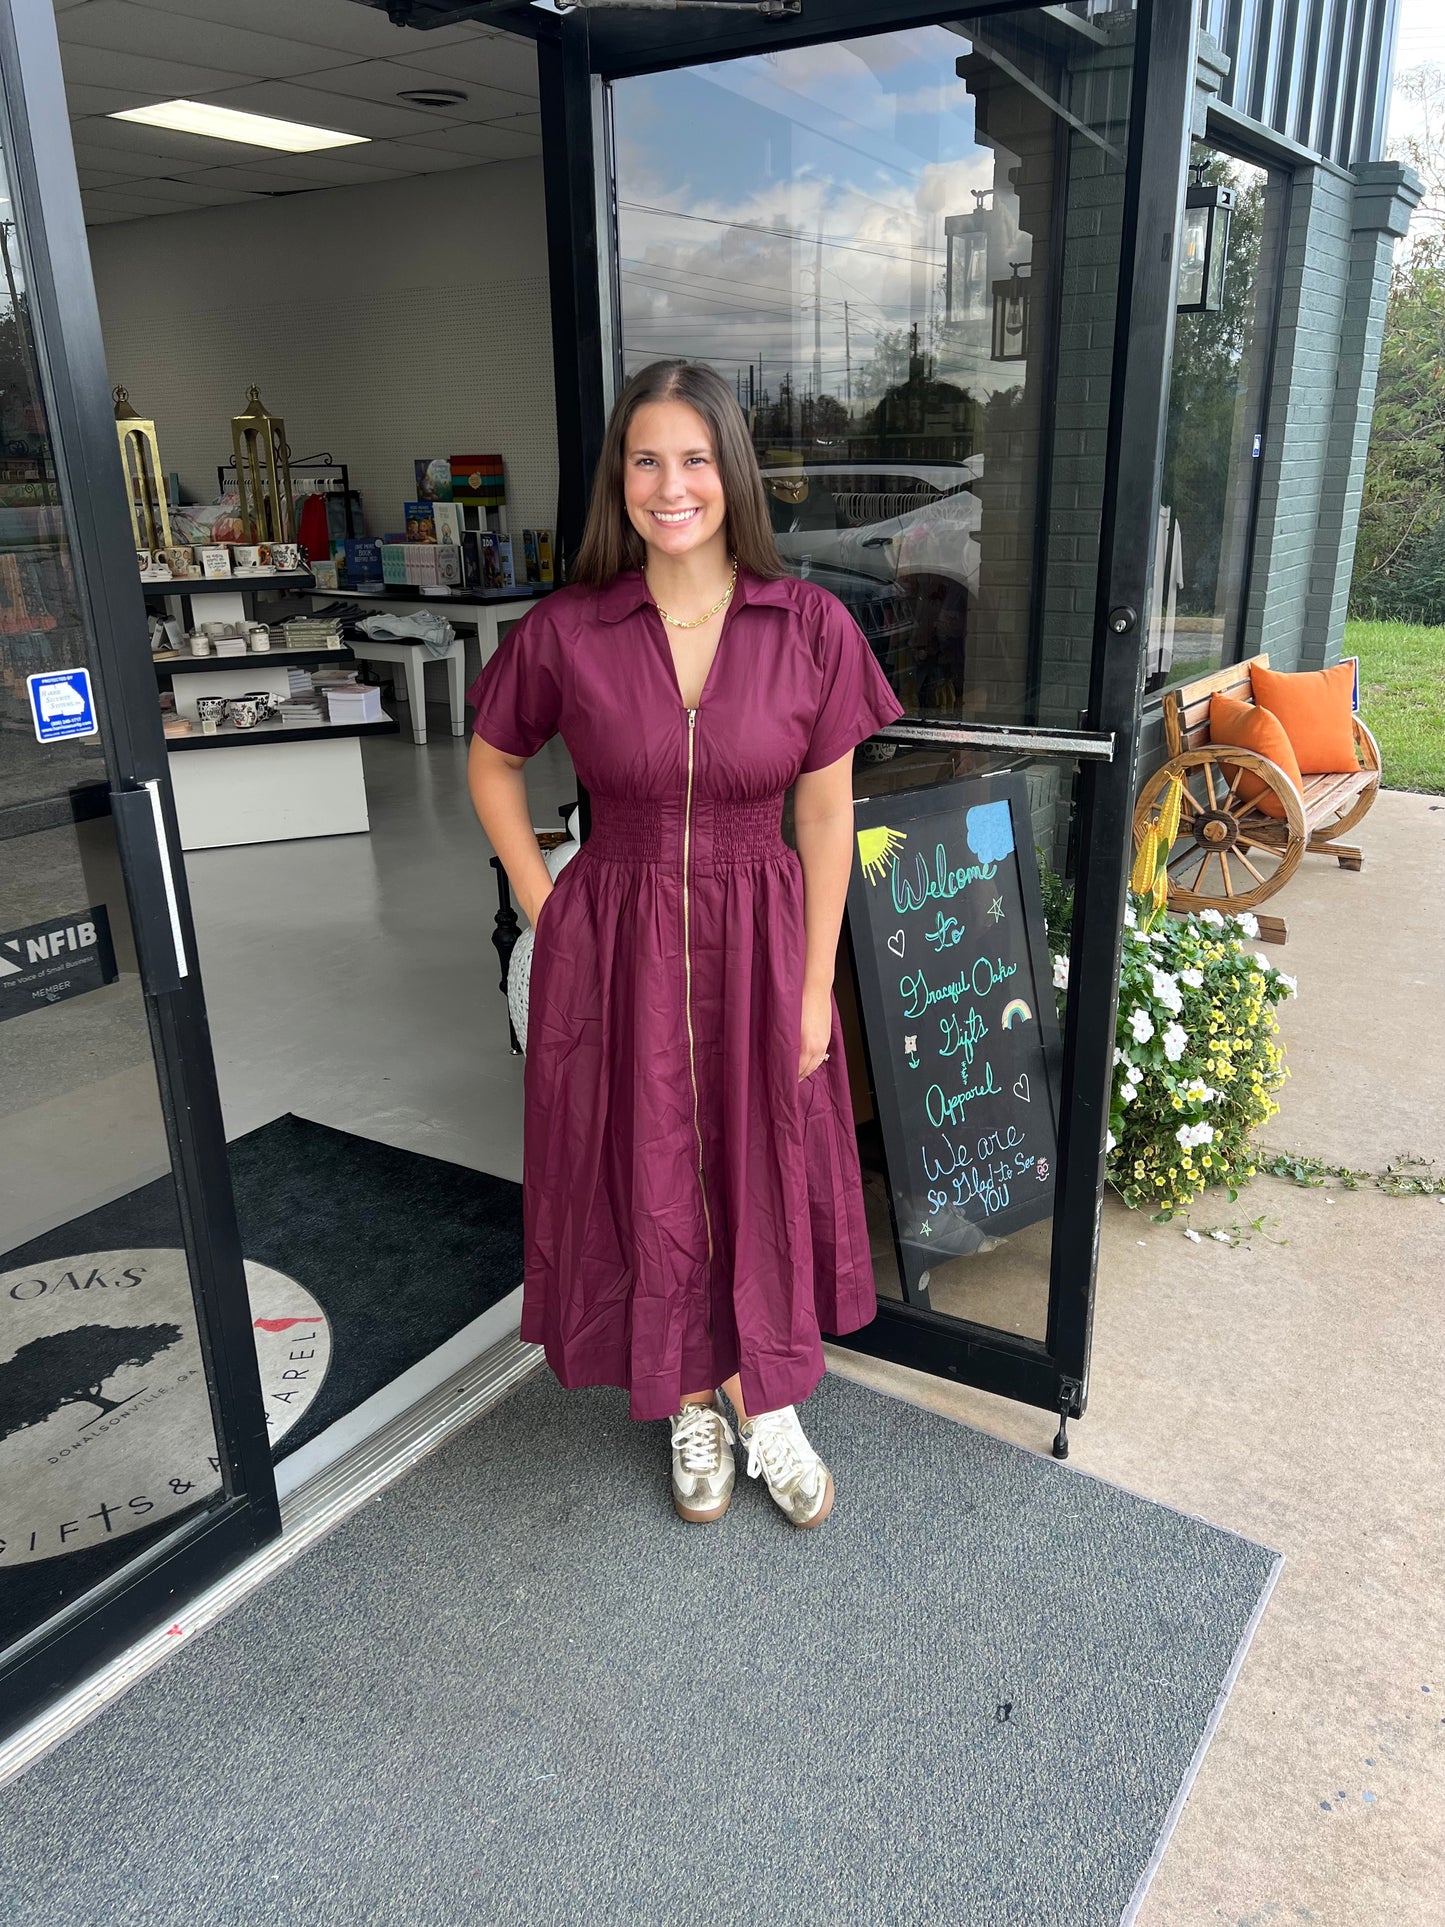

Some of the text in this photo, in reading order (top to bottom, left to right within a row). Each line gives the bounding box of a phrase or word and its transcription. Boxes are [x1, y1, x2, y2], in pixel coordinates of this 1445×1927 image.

[892, 843, 997, 913] Welcome
[26, 922, 98, 964] NFIB
[925, 911, 965, 952] to
[2, 955, 94, 989] The Voice of Small Business
[31, 980, 71, 999] MEMBER
[900, 957, 1017, 1018] Graceful Oaks
[939, 1007, 989, 1064] Gifts
[926, 1061, 1002, 1127] Apparel
[922, 1126, 1026, 1181] We are
[952, 1163, 995, 1206] Glad
[994, 1161, 1013, 1182] to
[1014, 1152, 1035, 1175] See
[979, 1183, 1010, 1217] YOU
[9, 1267, 148, 1301] OAKS
[177, 1369, 198, 1382] GA
[169, 1478, 196, 1495] &
